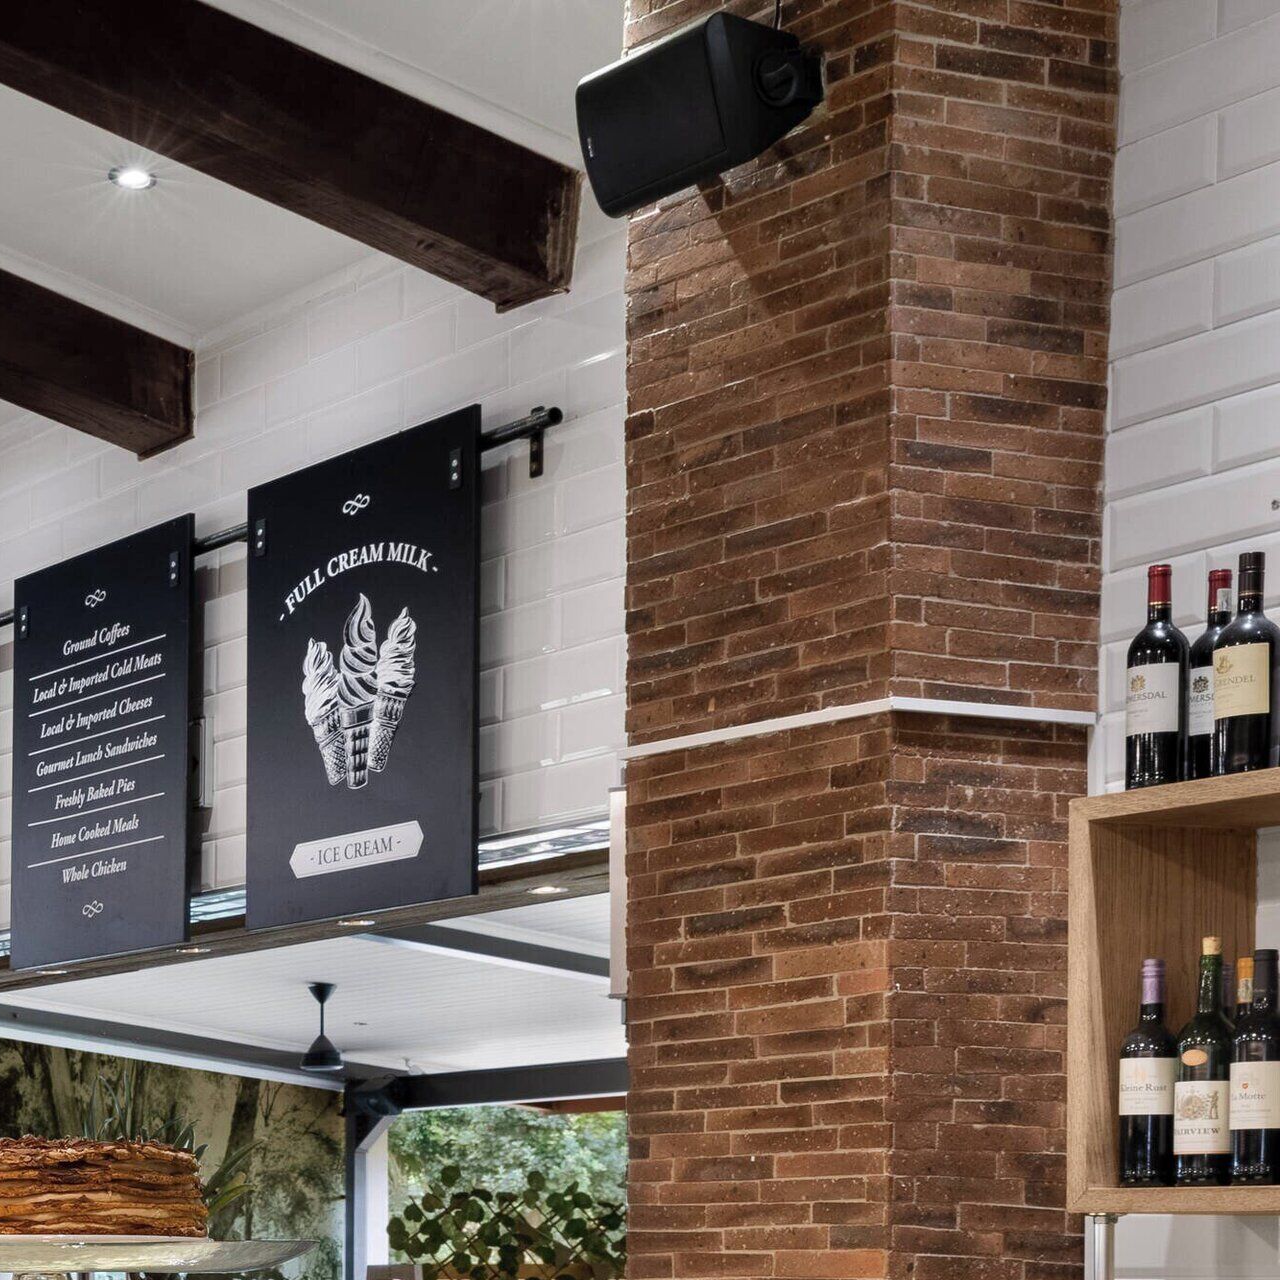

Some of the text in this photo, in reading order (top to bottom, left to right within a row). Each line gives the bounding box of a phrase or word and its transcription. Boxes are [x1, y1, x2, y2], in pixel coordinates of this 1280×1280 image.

[284, 542, 433, 614] FULL CREAM MILK
[63, 622, 130, 655] Ground Coffees
[33, 653, 162, 703] Local & Imported Cold Meats
[40, 696, 153, 739] Local & Imported Cheeses
[36, 732, 158, 777] Gourmet Lunch Sandwiches
[54, 778, 136, 810] Freshly Baked Pies
[51, 814, 140, 849] Home Cooked Meals
[318, 836, 394, 865] ICE CREAM
[62, 857, 127, 883] Whole Chicken
